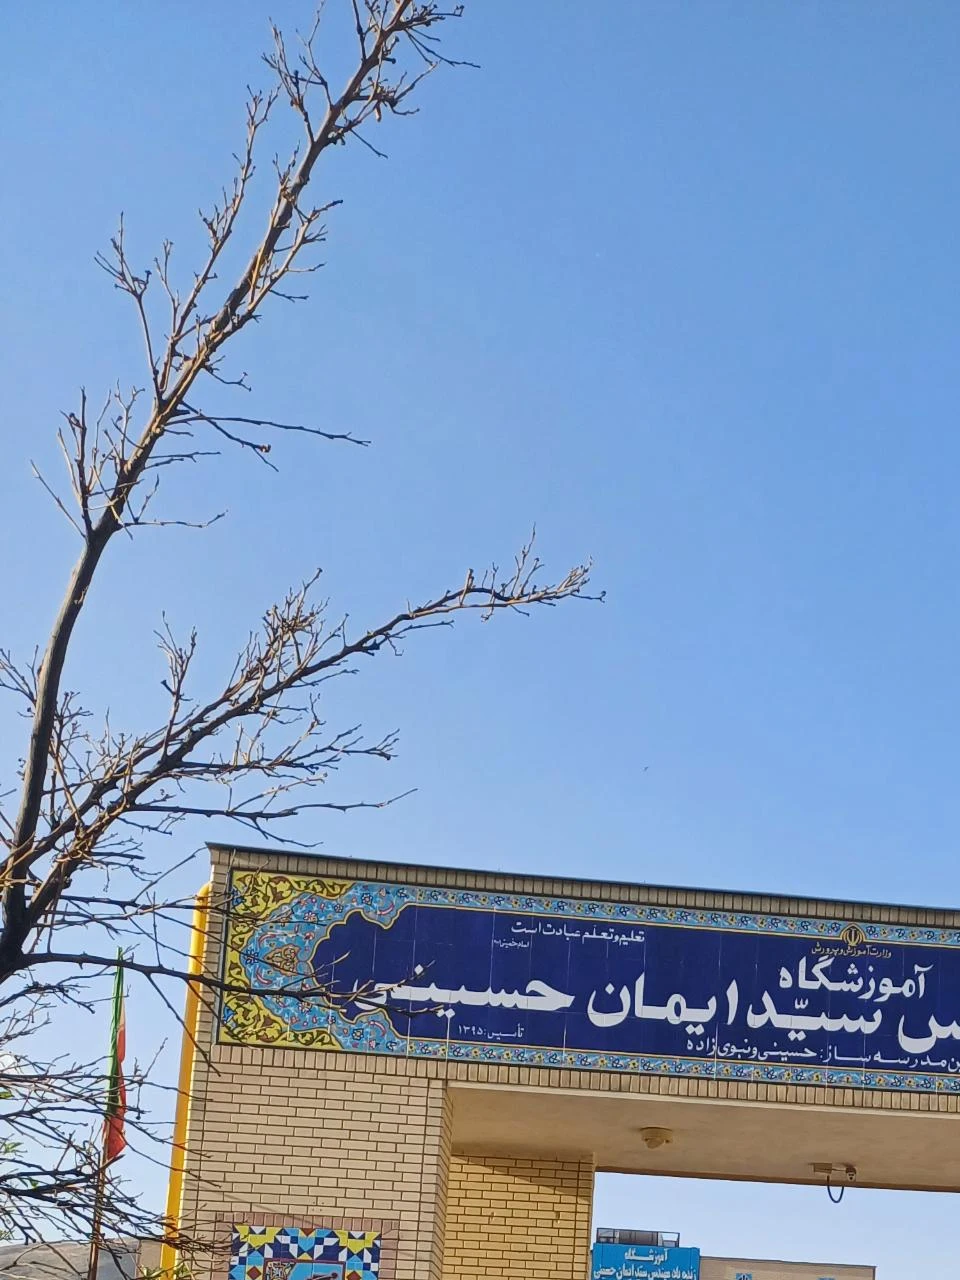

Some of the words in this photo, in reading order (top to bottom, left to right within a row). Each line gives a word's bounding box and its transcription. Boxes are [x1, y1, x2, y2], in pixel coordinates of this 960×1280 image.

[511, 921, 541, 933] است
[542, 923, 581, 941] عبادت
[619, 929, 645, 946] تعلیم
[779, 954, 934, 1002] آموزشگاه
[353, 964, 575, 1020] حسینی
[587, 972, 738, 1035] ایمان
[717, 1038, 751, 1059] نبوی
[757, 1042, 817, 1061] حسینی
[873, 1050, 946, 1068] مدرسه
[624, 1247, 671, 1265] آموزشگاه
